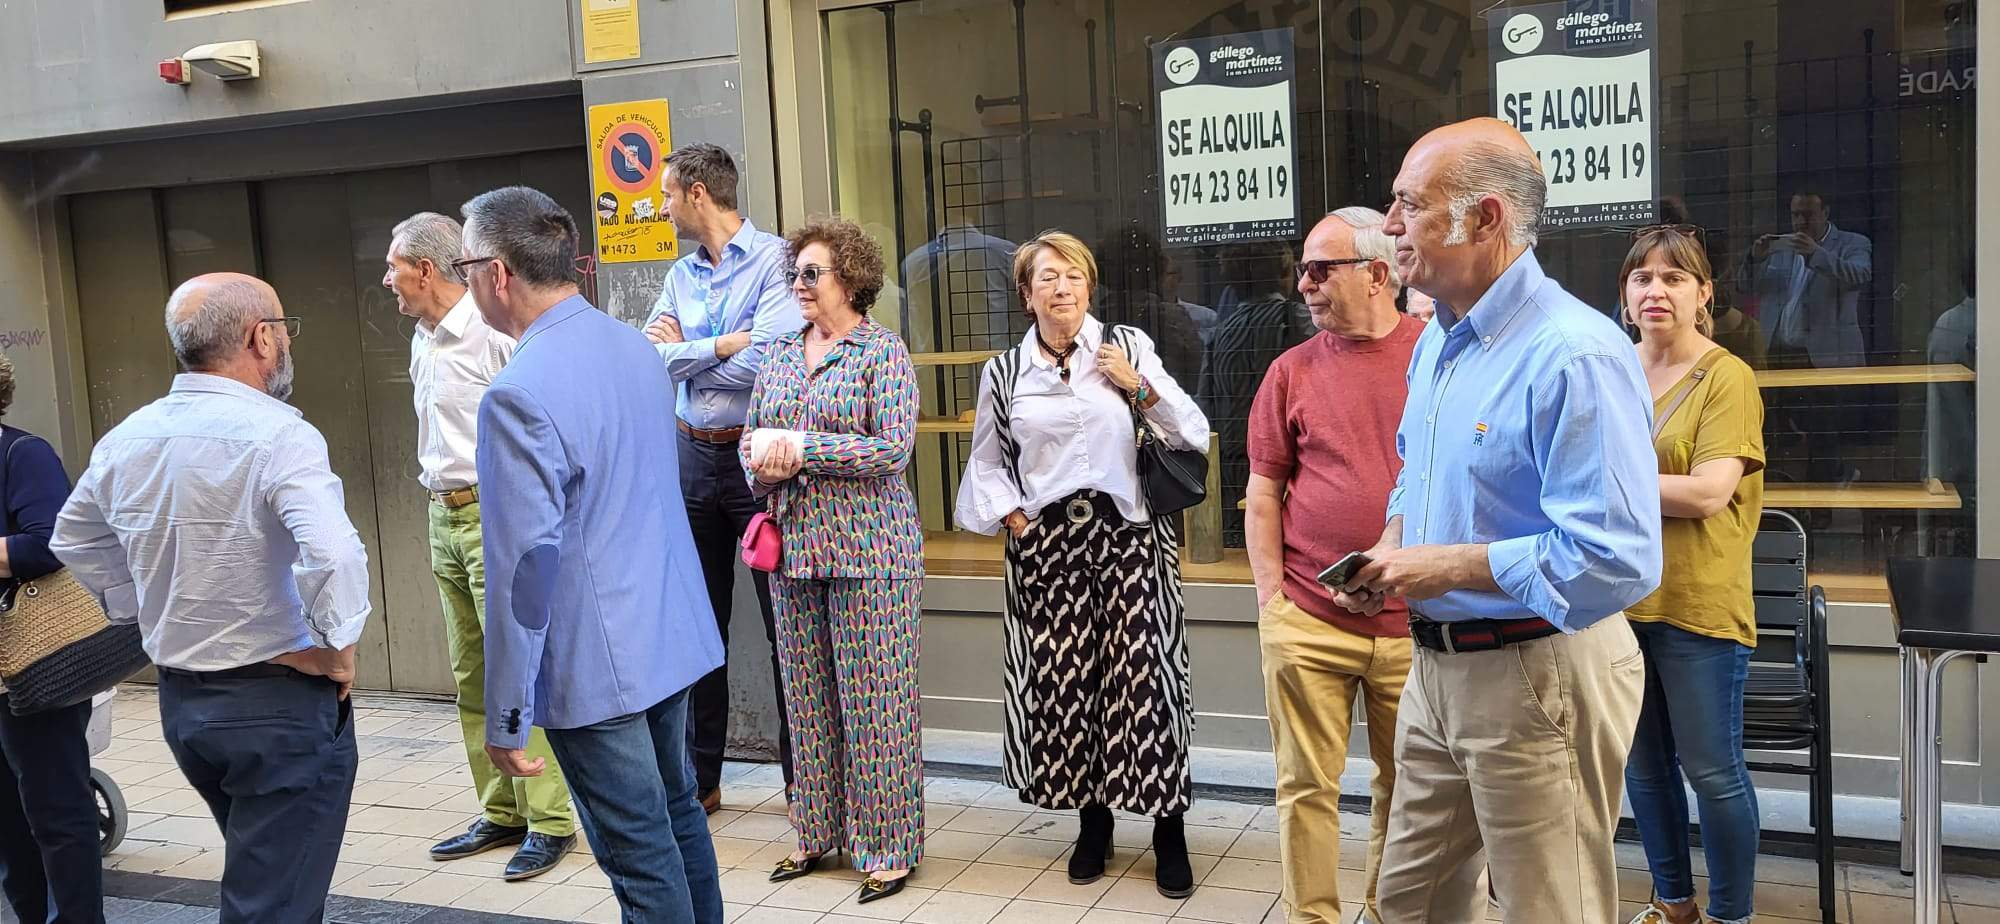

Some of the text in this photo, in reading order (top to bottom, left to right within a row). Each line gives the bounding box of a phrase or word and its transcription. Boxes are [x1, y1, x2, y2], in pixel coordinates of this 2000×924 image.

[1556, 12, 1609, 30] gállego
[1575, 22, 1642, 38] martínez
[1575, 33, 1643, 45] inmobiliaria
[1209, 46, 1254, 62] gállego
[1226, 55, 1282, 69] martínez
[1226, 66, 1282, 76] inmobiliaria
[1504, 82, 1643, 132] SE ALQUILA
[596, 122, 614, 150] SALIDA
[616, 114, 627, 123] DE
[1168, 110, 1285, 158] SE ALQUILA
[1551, 148, 1576, 184] 23
[1584, 145, 1610, 182] 84
[1622, 142, 1645, 179] 19
[1170, 165, 1287, 206] 974 23 84 19
[1601, 203, 1652, 212] Huesca
[600, 215, 619, 226] VADO
[1252, 221, 1295, 229] Huesca
[1542, 212, 1652, 226] llegomartinez.com
[1167, 228, 1295, 243] www.gallegomartinez.com
[656, 241, 673, 252] 3M
